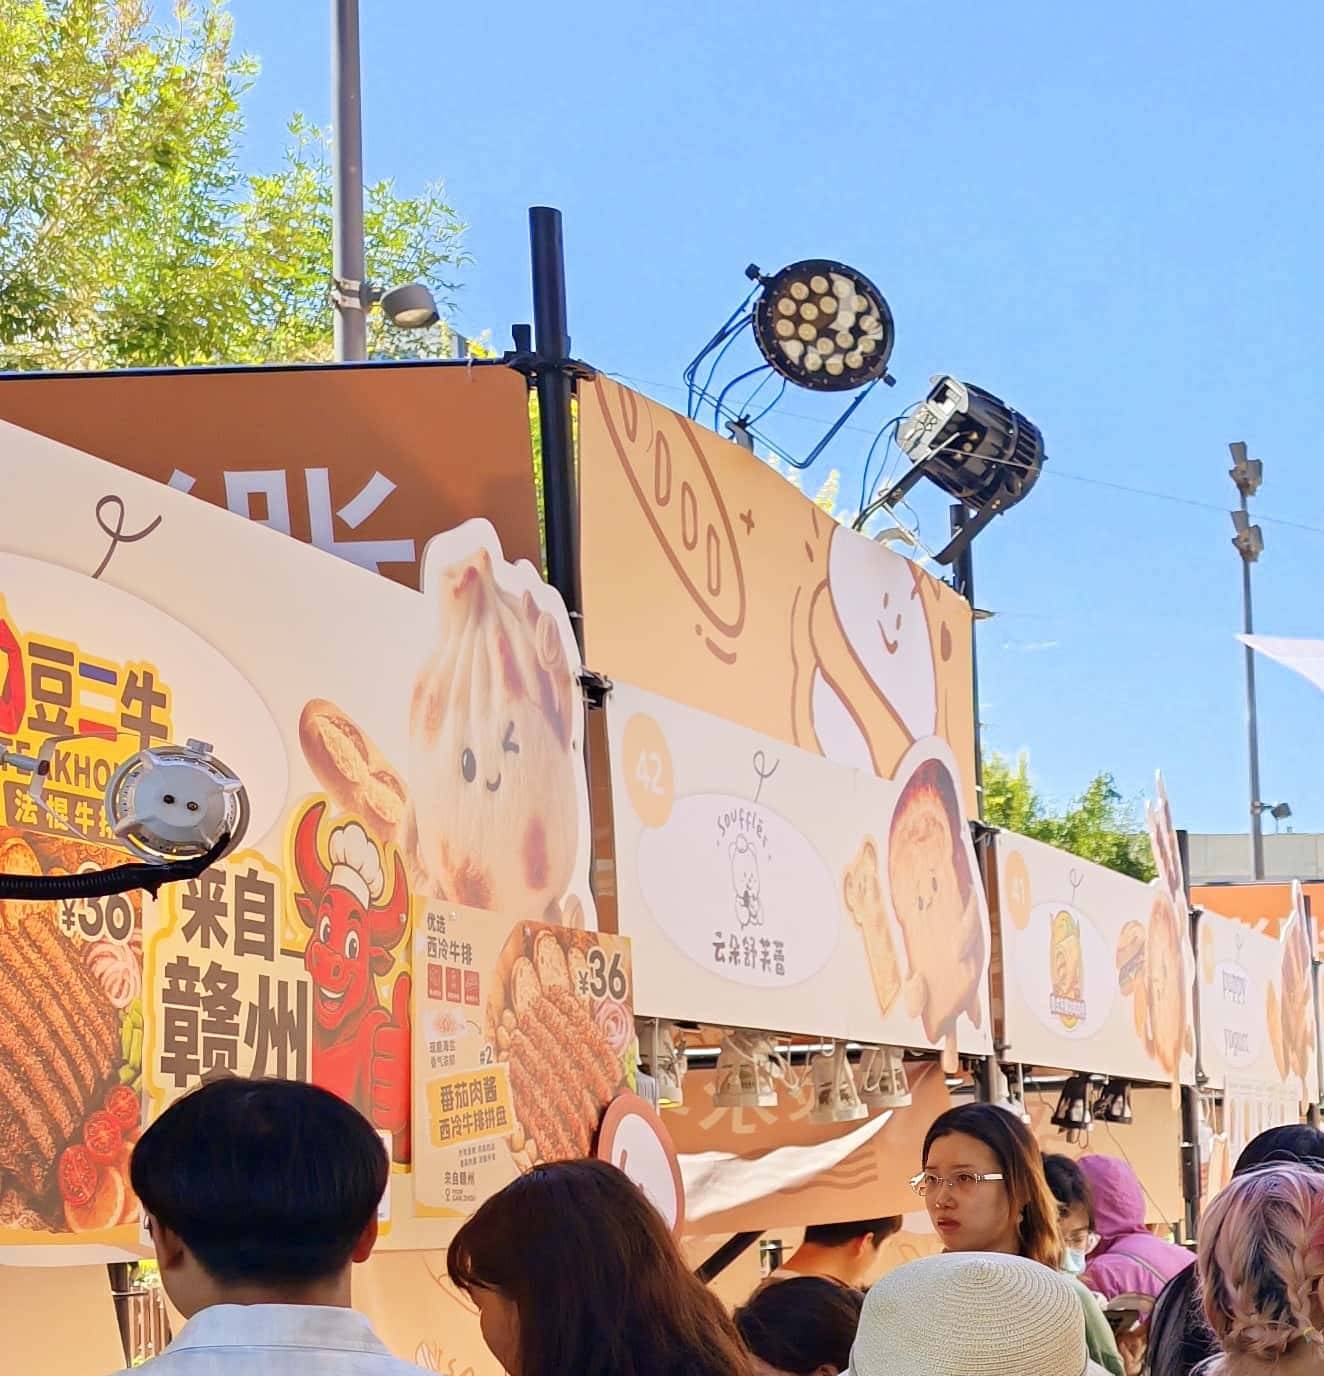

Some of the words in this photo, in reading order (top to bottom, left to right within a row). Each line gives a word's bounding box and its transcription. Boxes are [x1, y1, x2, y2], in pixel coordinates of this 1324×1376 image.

[634, 751, 665, 796] 42
[181, 868, 276, 962] 来自
[427, 935, 473, 967] 西冷牛排
[577, 949, 628, 1001] ¥36
[160, 956, 308, 1089] 赣州
[440, 1076, 498, 1113] 番茄肉酱
[439, 1105, 508, 1141] 西冷牛排拼盘
